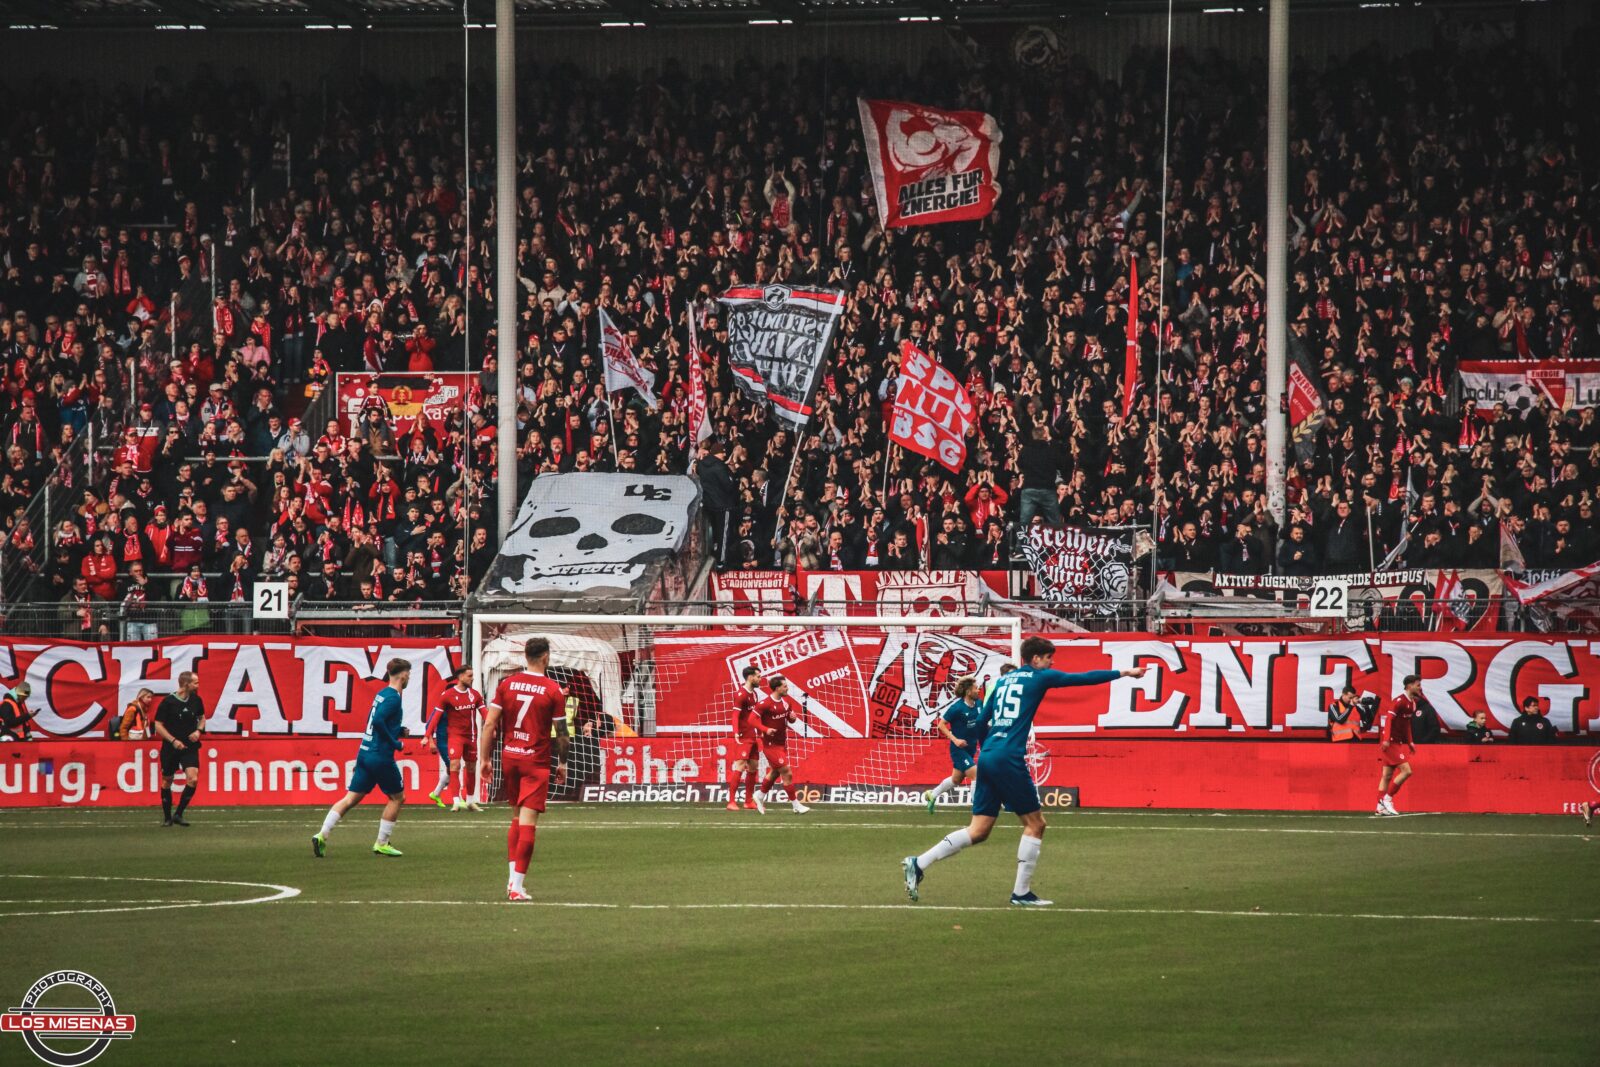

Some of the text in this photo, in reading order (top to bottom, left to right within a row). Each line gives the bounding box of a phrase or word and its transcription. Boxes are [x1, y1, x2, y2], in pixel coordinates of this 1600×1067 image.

[898, 177, 946, 201] ALLES
[901, 189, 979, 217] ENERGIE!
[893, 412, 960, 466] BSG
[1030, 525, 1115, 556] Freiheit
[1058, 550, 1085, 570] für
[1258, 575, 1299, 589] JUGEND
[1373, 570, 1424, 587] COTTBUS
[260, 588, 282, 611] 21
[1315, 586, 1343, 610] 22
[749, 631, 828, 673] ENERGIE
[509, 682, 547, 695] ENERGIE
[806, 665, 851, 690] COTTBUS
[514, 694, 535, 728] 7
[994, 684, 1023, 720] 35
[583, 785, 699, 803] Eisenbach
